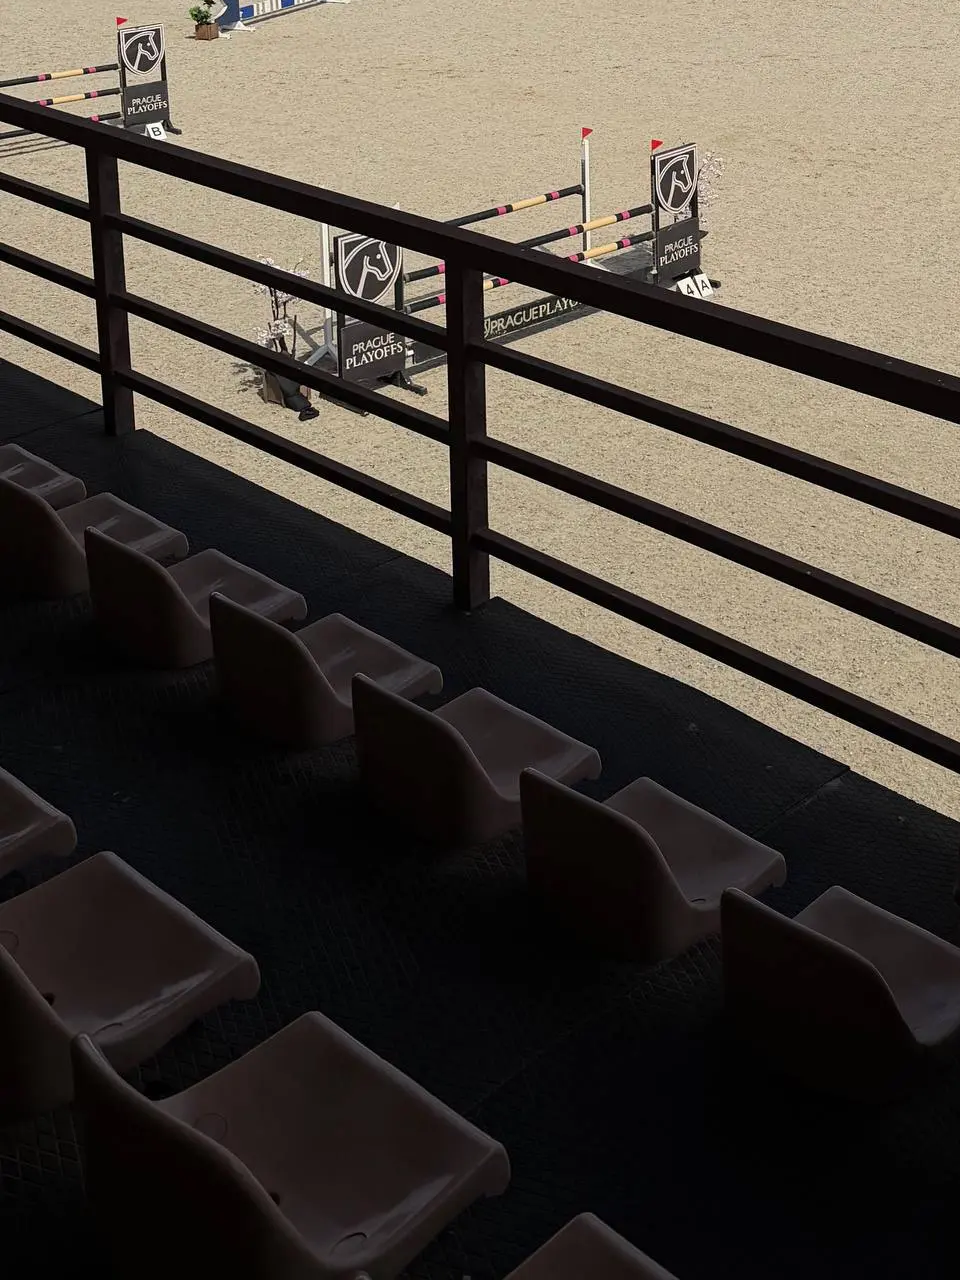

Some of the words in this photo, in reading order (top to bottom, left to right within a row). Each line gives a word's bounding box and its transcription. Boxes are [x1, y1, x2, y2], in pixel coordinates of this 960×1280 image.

[127, 100, 168, 115] PLAYOFFS
[131, 94, 162, 106] PRAGUE
[151, 126, 162, 136] B
[664, 235, 693, 254] PRAGUE
[660, 243, 699, 266] PLAYOFFS
[686, 283, 695, 295] 4
[700, 279, 710, 291] A
[352, 332, 395, 355] PRAGUE
[345, 341, 404, 370] PLAYOFFS
